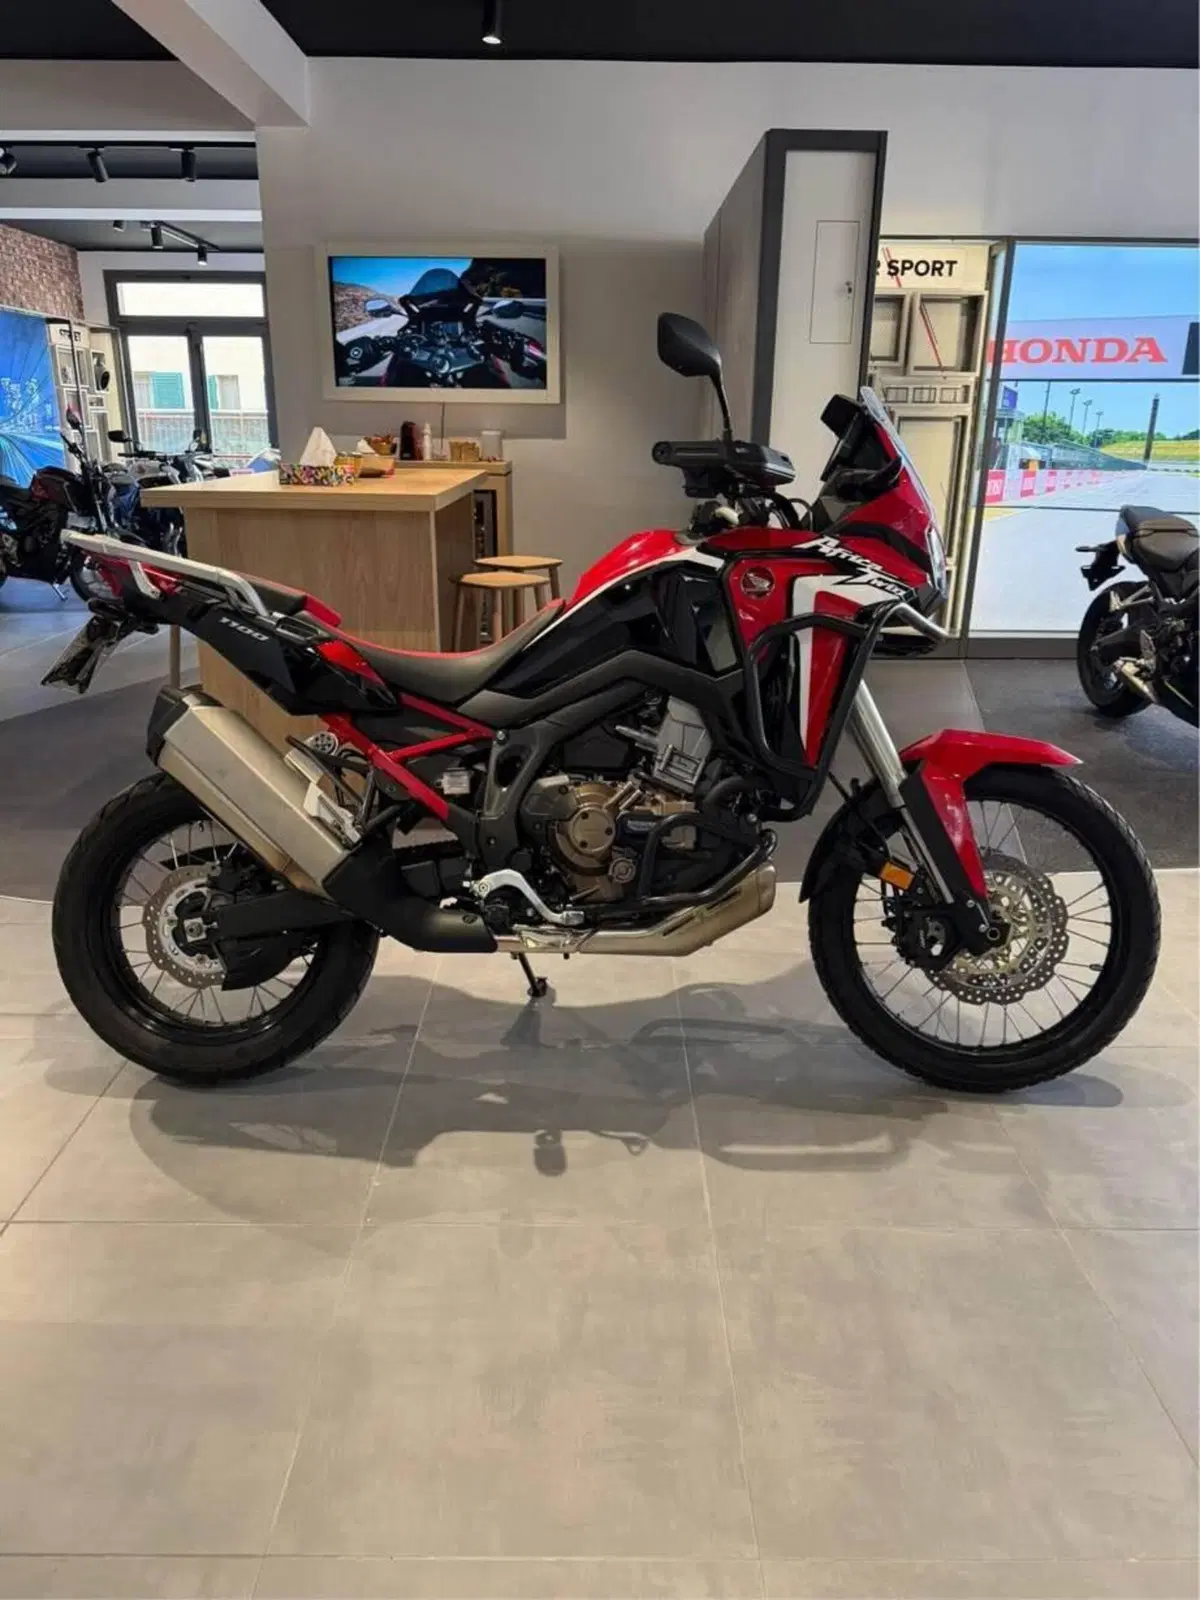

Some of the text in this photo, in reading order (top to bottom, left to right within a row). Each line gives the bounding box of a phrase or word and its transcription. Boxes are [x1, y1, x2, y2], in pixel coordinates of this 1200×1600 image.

[887, 259, 958, 277] SPORT
[986, 336, 1168, 364] HONDA
[792, 536, 883, 571] Africa
[219, 616, 269, 641] 1100
